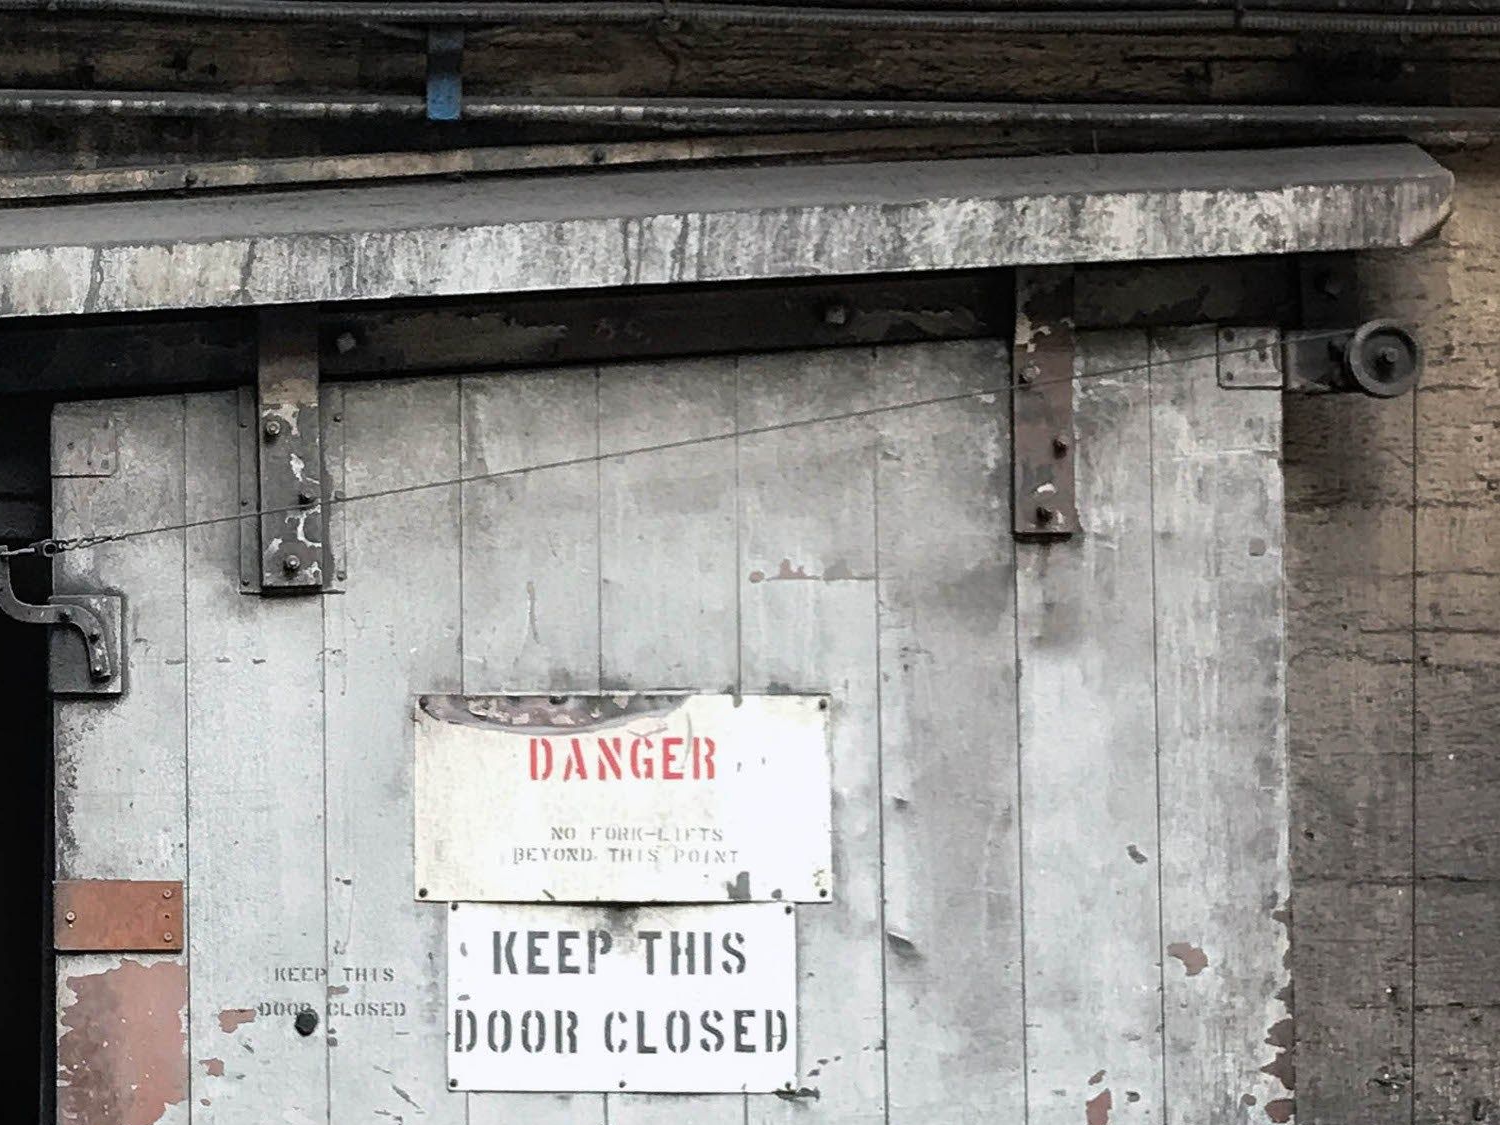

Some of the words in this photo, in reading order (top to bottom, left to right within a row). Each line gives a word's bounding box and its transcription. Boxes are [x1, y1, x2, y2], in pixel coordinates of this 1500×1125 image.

[529, 737, 715, 781] DANGER
[551, 826, 577, 841] NO
[590, 826, 724, 842] FORK-LIFTS
[607, 847, 660, 864] THIS
[674, 849, 739, 865] POINT
[493, 930, 613, 975] KEEP
[638, 930, 747, 975] THIS
[275, 967, 328, 982] KEEP
[342, 967, 395, 982] THIS
[325, 1001, 407, 1017] CLOSED
[455, 1009, 579, 1054] DOOR
[604, 1009, 788, 1054] CLOSED
